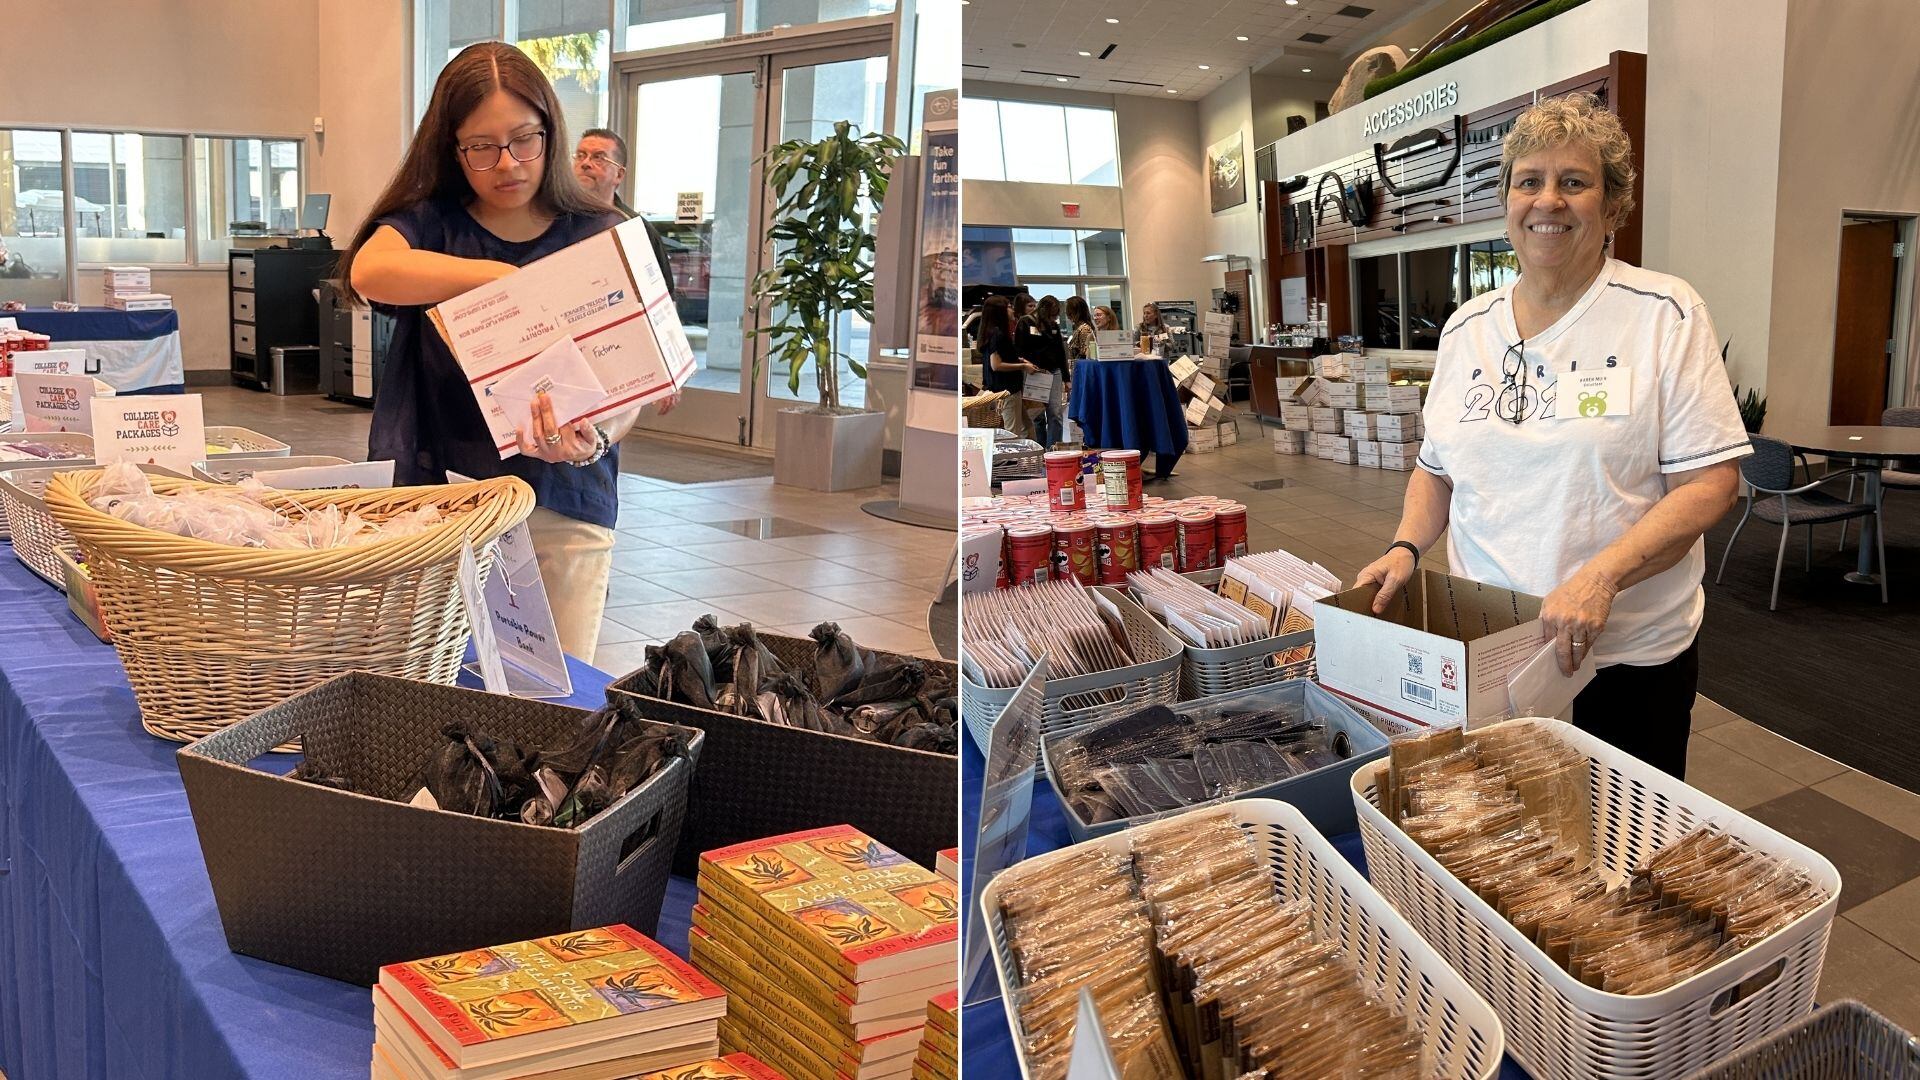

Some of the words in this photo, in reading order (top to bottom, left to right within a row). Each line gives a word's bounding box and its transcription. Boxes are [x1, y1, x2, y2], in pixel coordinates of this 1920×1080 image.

[1363, 82, 1458, 137] ACCESSORIES
[934, 146, 954, 157] Take
[933, 160, 947, 170] fun
[34, 362, 57, 370] COLLEGE
[39, 386, 65, 395] COLLEGE
[50, 394, 66, 402] CARE
[36, 400, 68, 410] PACKAGES
[123, 411, 159, 422] COLLEGE
[137, 420, 160, 429] CARE
[116, 429, 161, 439] PACKAGES
[495, 610, 524, 633] Portable
[523, 624, 546, 644] Power
[516, 636, 535, 655] Bank
[1380, 717, 1408, 733] PRIORITY
[796, 881, 836, 896] THE
[841, 867, 896, 884] FOUR
[796, 874, 922, 907] AGREEMENTS
[768, 906, 784, 923] FOUR
[755, 918, 766, 930] THE
[768, 926, 785, 943] FOUR
[766, 945, 781, 963] FOUR
[865, 942, 895, 955] DON
[503, 950, 583, 1011] AGREEMENTS
[528, 951, 555, 970] THE
[554, 971, 592, 999] FOUR
[752, 976, 764, 988] THE
[766, 982, 785, 1001] FOUR
[397, 967, 415, 982] DON
[416, 982, 447, 1011] MIGUEL
[445, 1010, 469, 1032] RUIZ
[763, 1000, 781, 1018] FOUR
